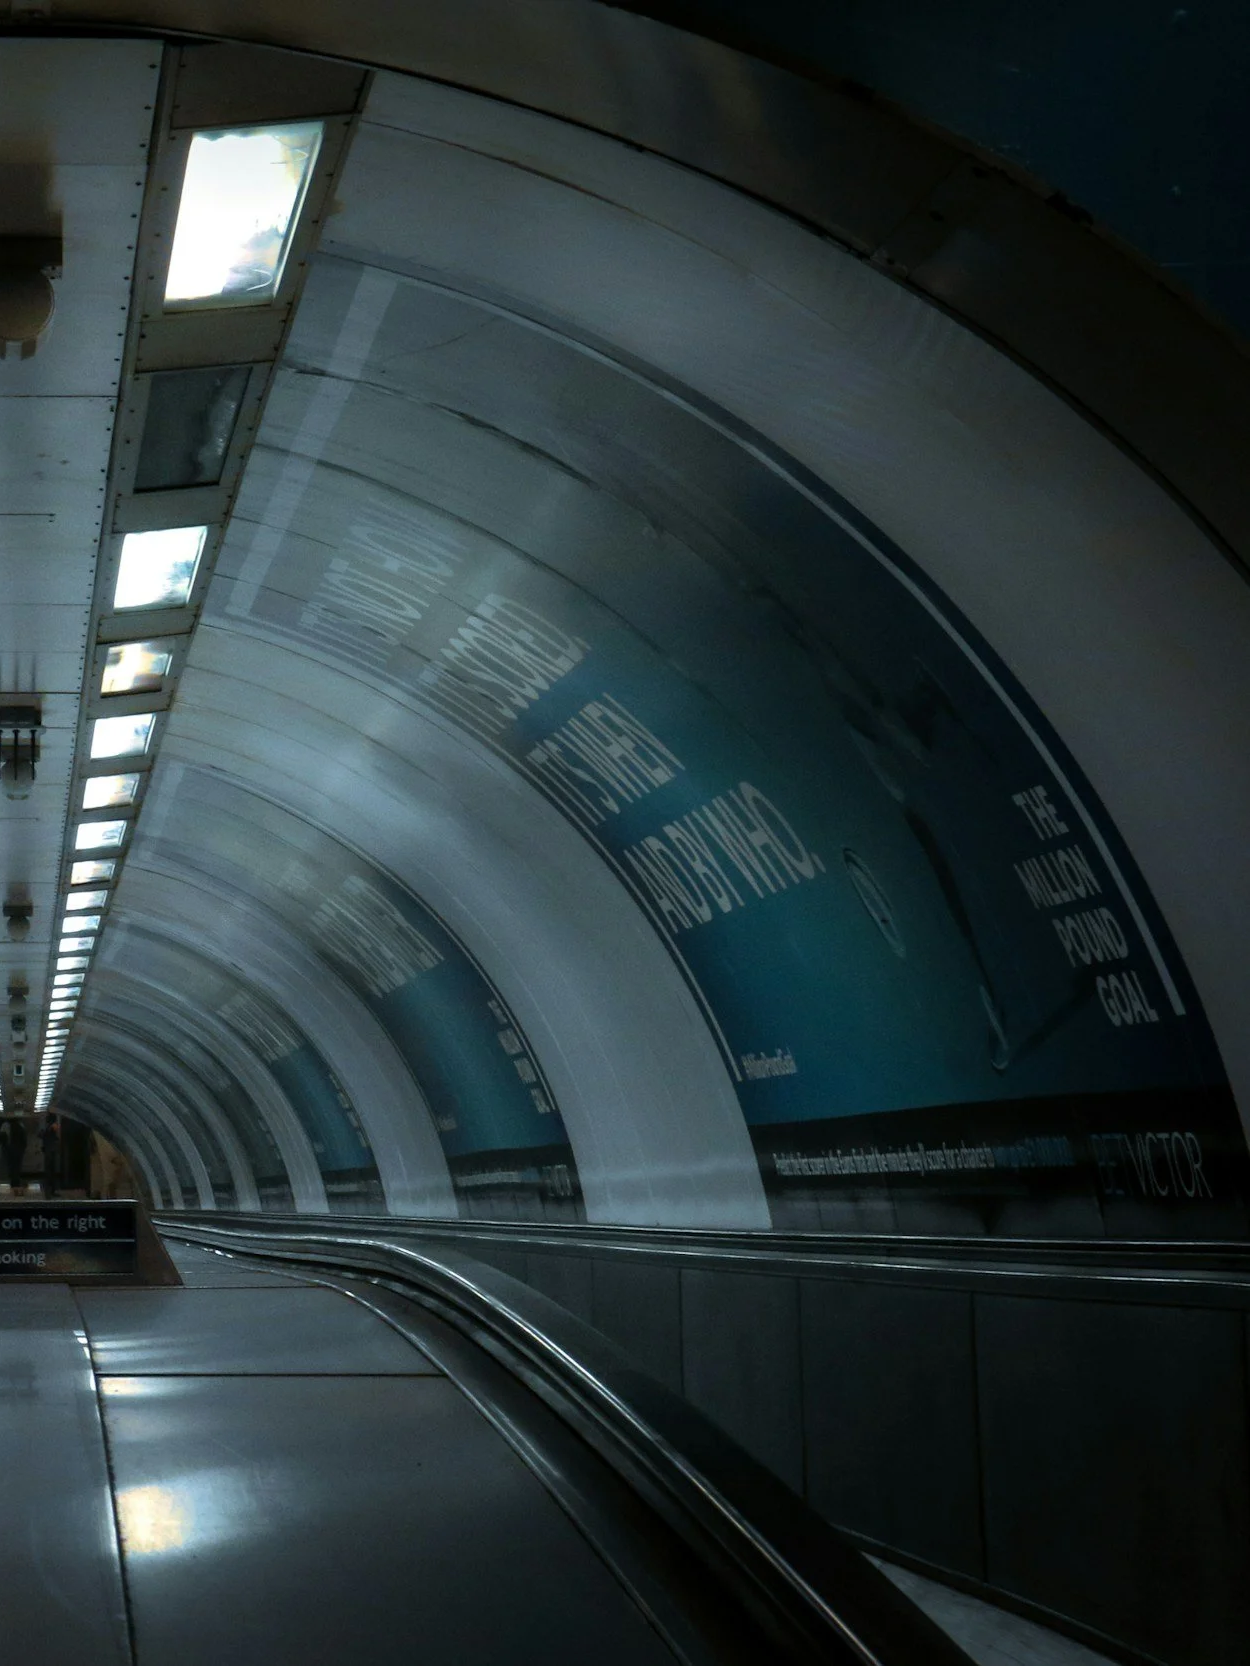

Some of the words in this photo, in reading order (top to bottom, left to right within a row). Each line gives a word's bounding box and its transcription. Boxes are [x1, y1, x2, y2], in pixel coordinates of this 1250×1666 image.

[341, 497, 468, 594] HOW
[313, 558, 430, 634] NOT
[442, 593, 592, 710] SCORED,
[419, 658, 519, 736] IT'S
[527, 738, 620, 826] IT'S
[554, 692, 685, 803] WHEN
[703, 781, 826, 898] WHO.
[1012, 785, 1069, 841] THE
[624, 836, 712, 933] AND
[663, 815, 744, 913] BY
[1014, 844, 1102, 909] MILLION
[1052, 907, 1130, 967] POUND
[1094, 970, 1159, 1027] GOAL
[1, 1217, 23, 1230] on
[30, 1214, 59, 1230] the
[66, 1214, 107, 1233] right
